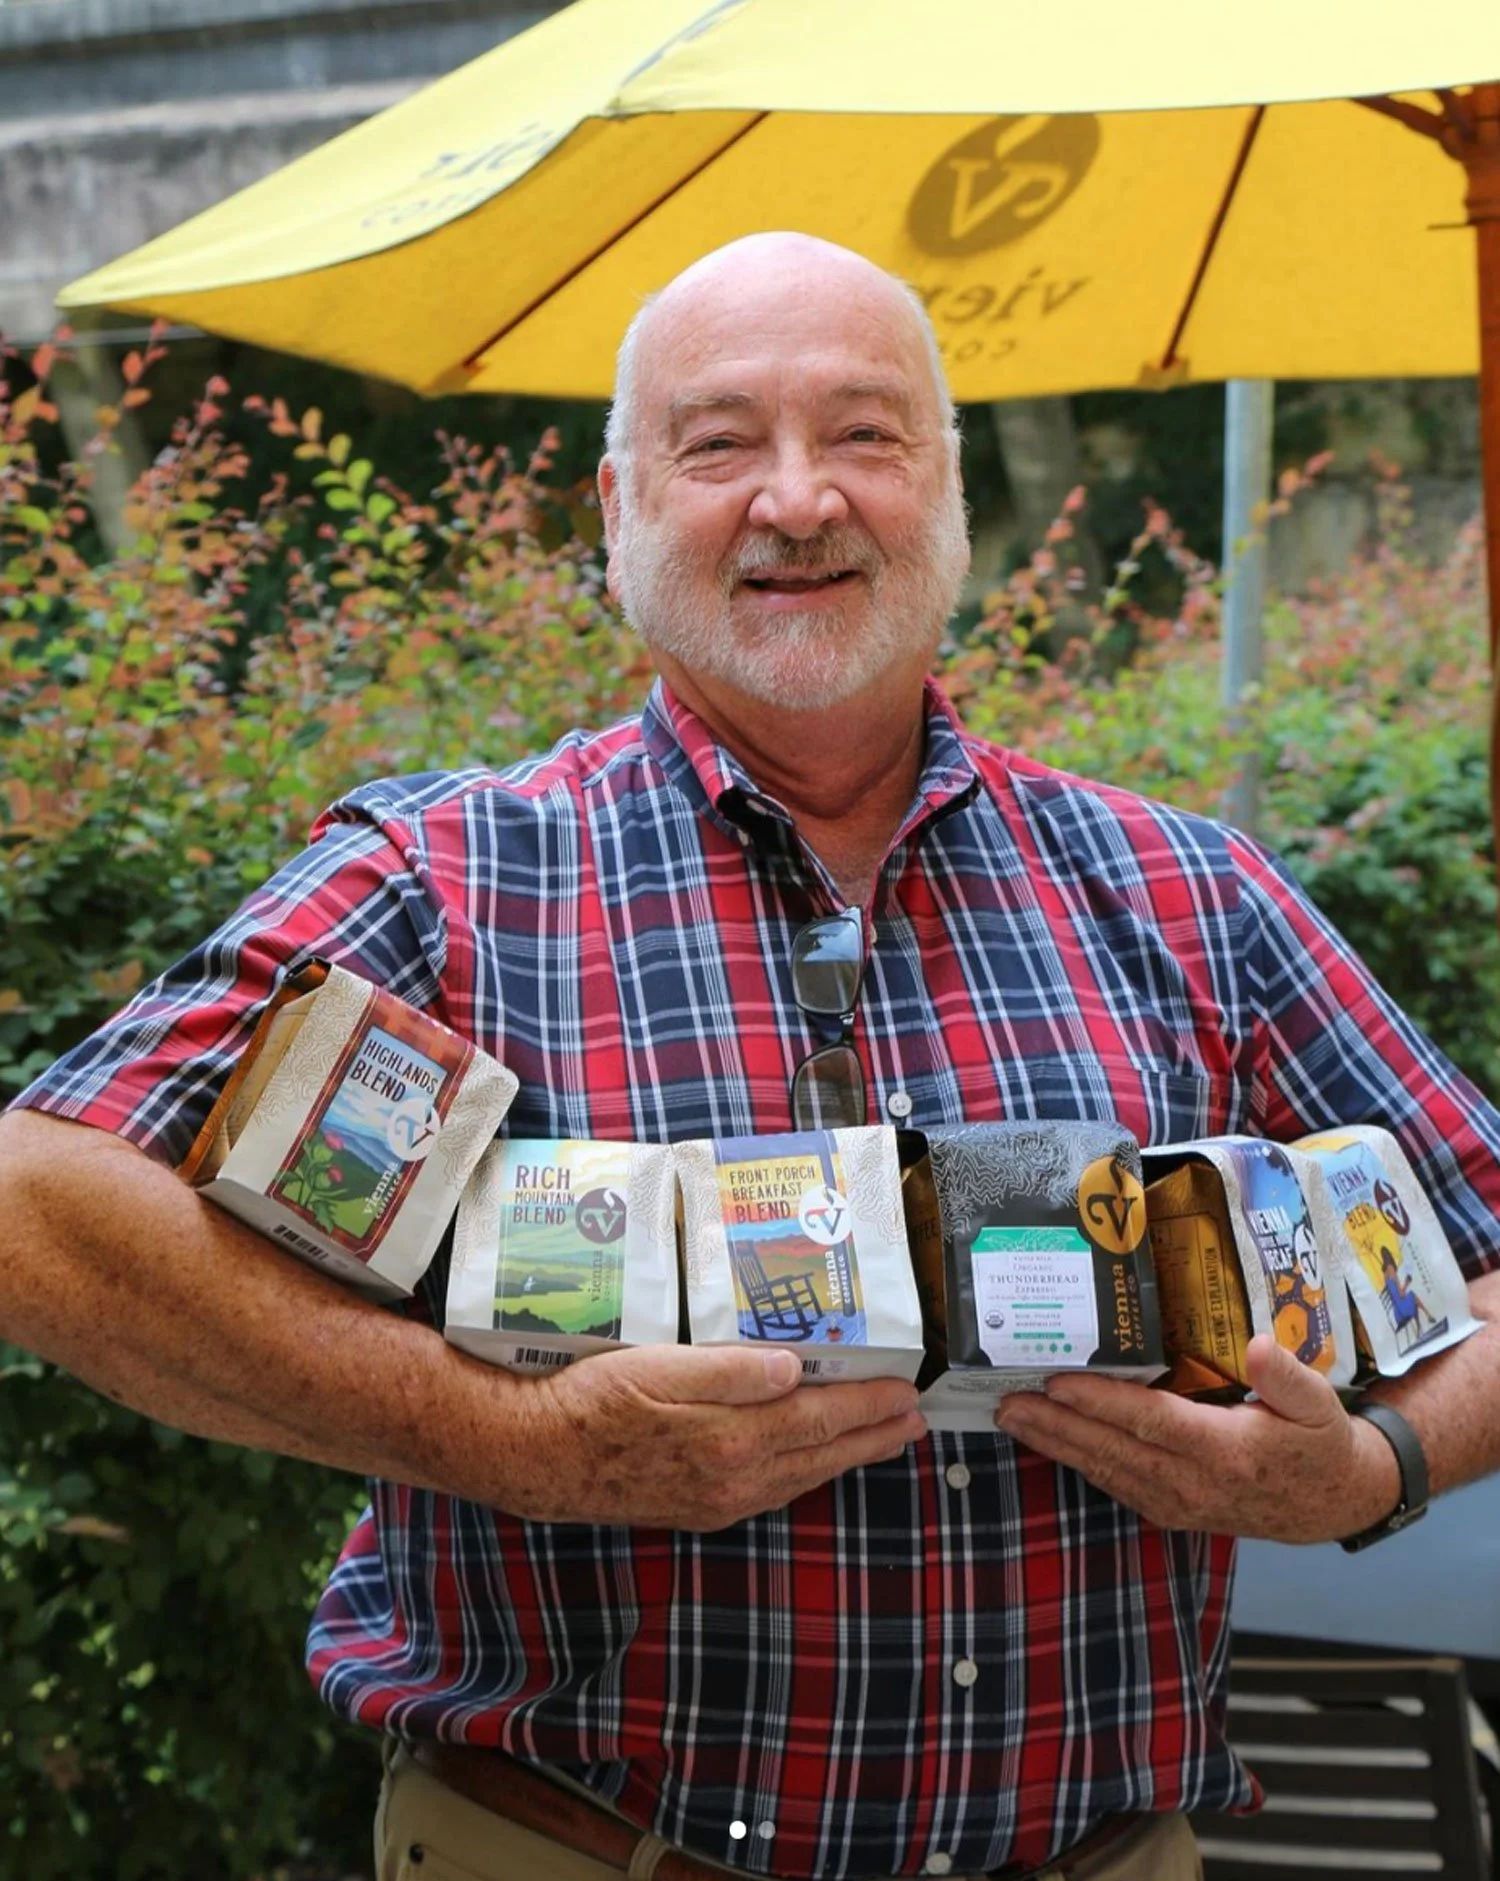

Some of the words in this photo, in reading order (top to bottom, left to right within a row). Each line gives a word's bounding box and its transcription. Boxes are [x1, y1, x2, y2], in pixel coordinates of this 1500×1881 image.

[350, 1058, 407, 1103] BLEND
[363, 1038, 439, 1095] HIGHLANDS
[363, 1161, 399, 1214] vienna
[515, 1164, 571, 1190] RICH
[729, 1167, 770, 1186] FRONT
[776, 1165, 815, 1182] PORCH
[731, 1182, 803, 1202] BREAKFAST
[1326, 1164, 1369, 1197] VIENNA
[515, 1190, 575, 1206] MOUNTAIN
[735, 1200, 791, 1224] BLEND
[513, 1206, 567, 1225] BLEND
[1248, 1205, 1292, 1236] VIENNA
[588, 1249, 603, 1303] vienna
[824, 1250, 841, 1306] vienna
[989, 1273, 1080, 1284] THUNDERHEAD
[1204, 1246, 1225, 1312] EXPLANATION
[1112, 1263, 1133, 1351] vienna
[1211, 1313, 1231, 1358] BREWING
